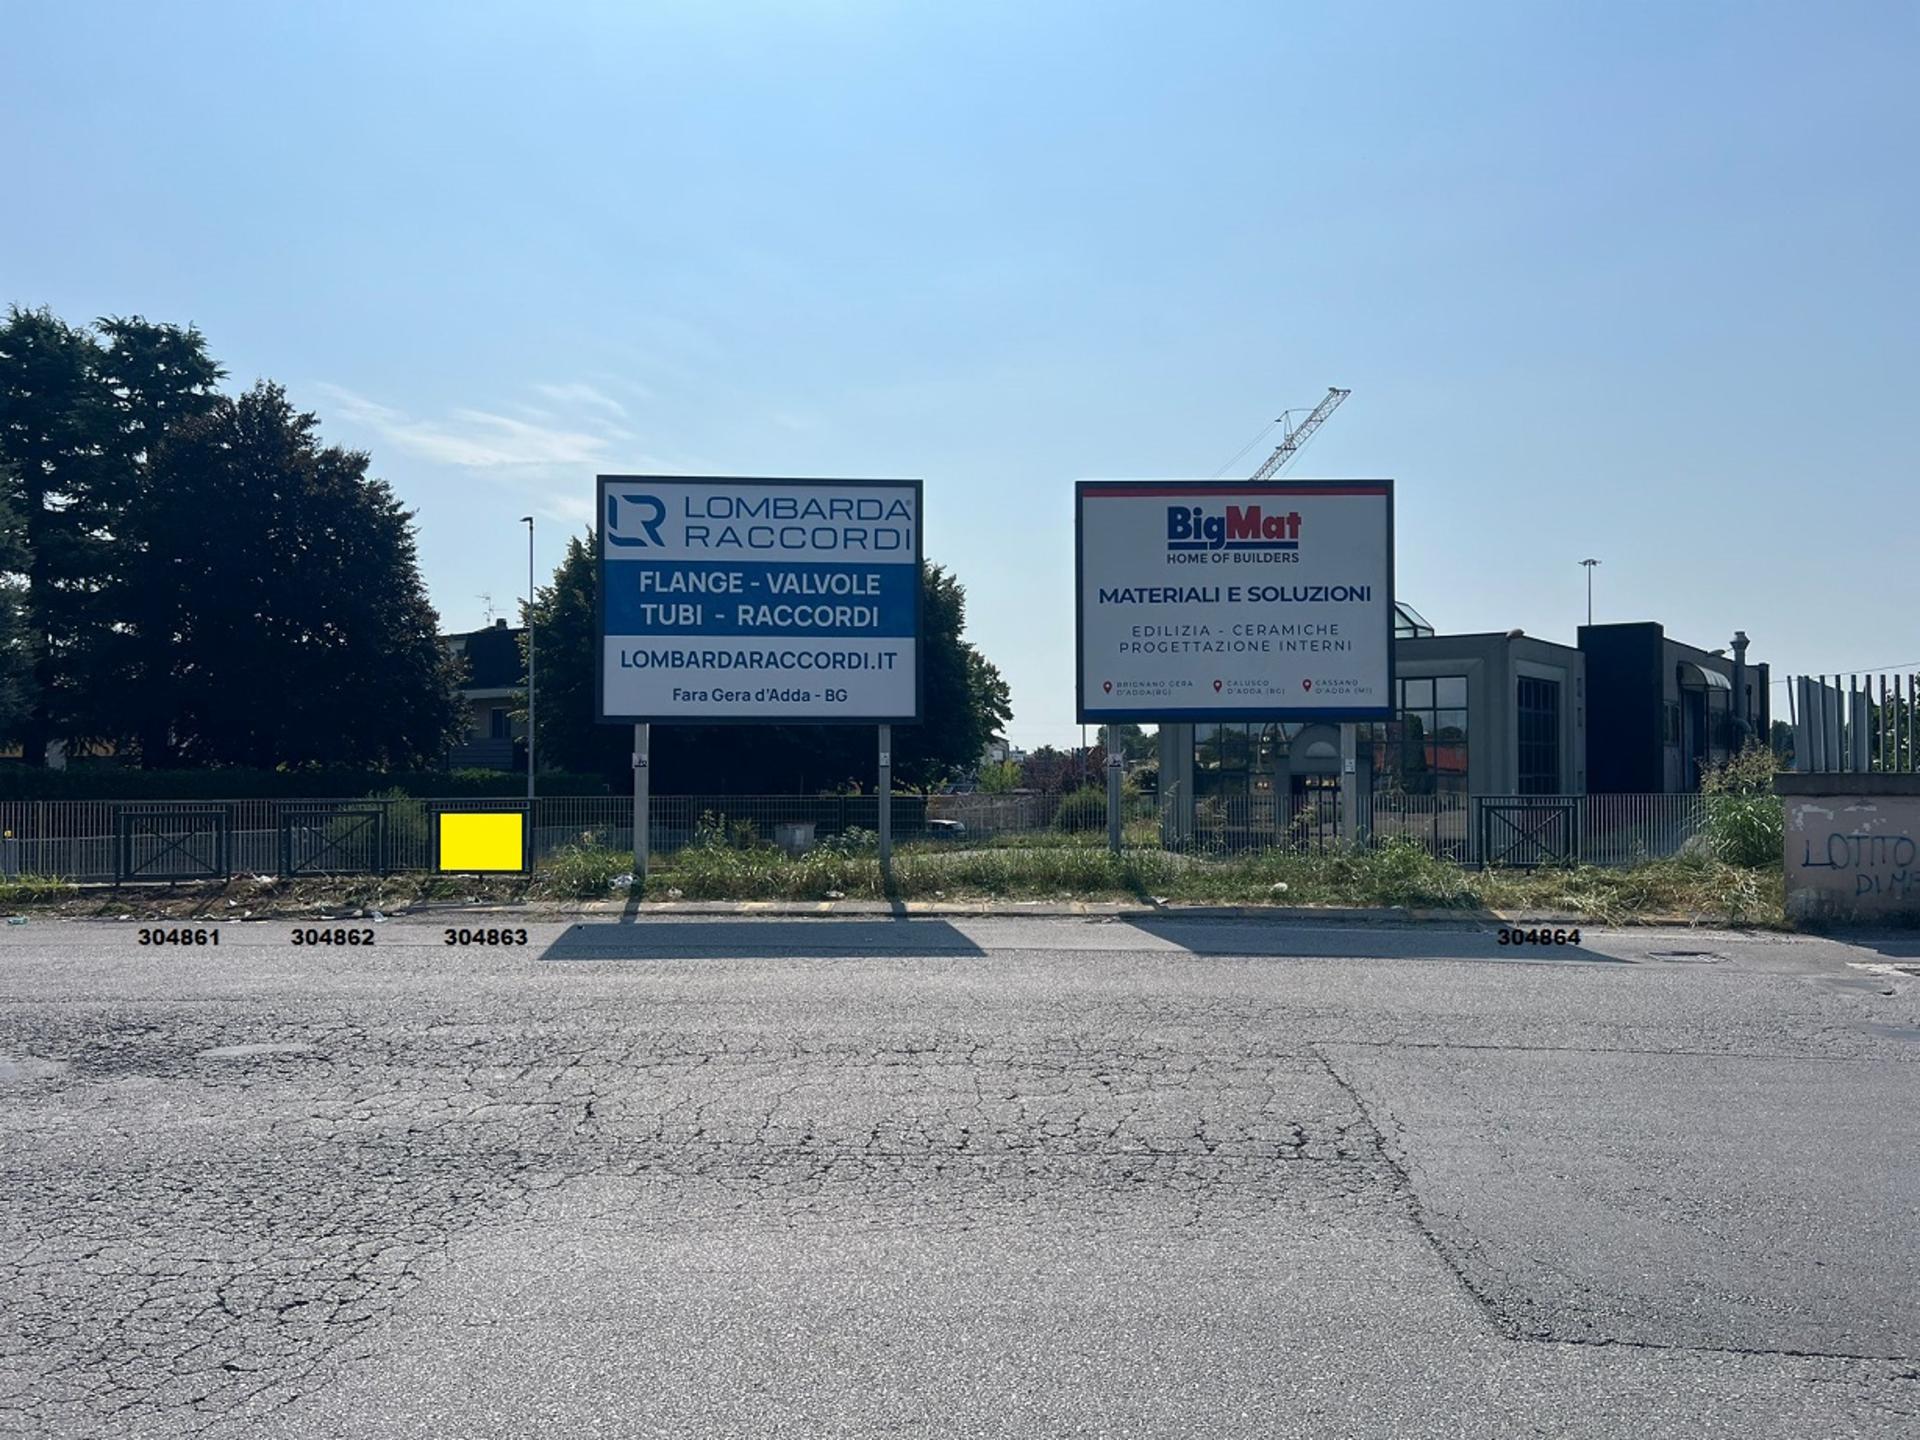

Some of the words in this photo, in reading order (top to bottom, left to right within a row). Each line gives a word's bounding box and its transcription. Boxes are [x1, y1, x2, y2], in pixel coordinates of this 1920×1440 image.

[1167, 505, 1302, 550] BigMat
[685, 526, 910, 550] RACCORDI
[1167, 553, 1208, 564] HOME
[1212, 553, 1230, 564] OF
[1234, 552, 1299, 564] BUILDERS
[639, 571, 744, 593] FLANGE
[767, 573, 881, 595] VALVOLE
[1099, 587, 1220, 604] MATERIALI
[1227, 587, 1241, 602] E
[1248, 586, 1371, 602] SOLUZIONI
[640, 604, 702, 625] TUBI
[738, 605, 879, 627] RACCORDI
[1132, 625, 1211, 637] EDILIZIA
[1232, 624, 1339, 636] CERAMICHE
[1119, 641, 1271, 654] PROGETTAZIONE
[1279, 640, 1352, 652] INTERNI
[621, 650, 897, 670] LOMBARDARACCORDI.IT
[673, 688, 708, 702] Fara
[712, 688, 751, 702] Gera
[755, 688, 811, 702] d'Adda
[826, 688, 848, 702] BG
[1856, 874, 1881, 896] DI
